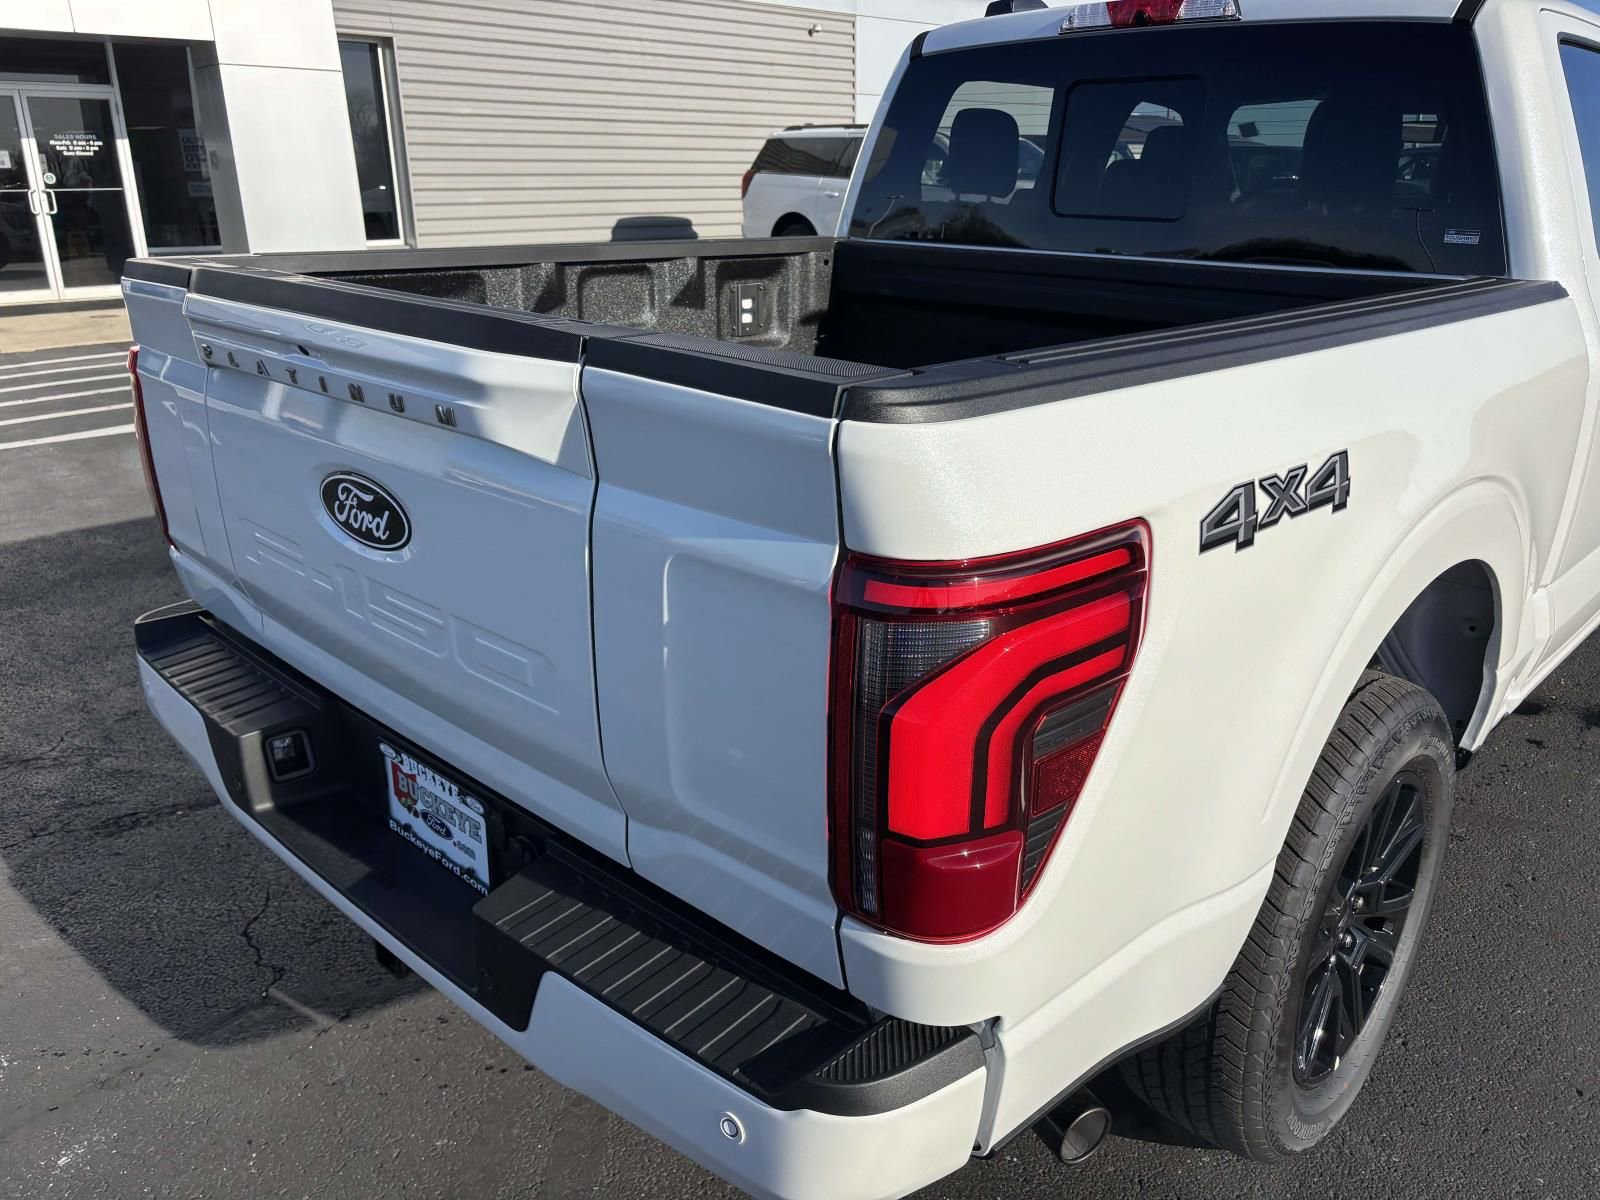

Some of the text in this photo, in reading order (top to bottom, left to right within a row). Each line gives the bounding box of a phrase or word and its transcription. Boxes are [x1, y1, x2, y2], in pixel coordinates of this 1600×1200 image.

[201, 343, 458, 427] PLATINUM
[239, 517, 560, 715] F-150
[398, 770, 482, 843] BUCKEYE
[389, 819, 489, 897] BuckeyeFord.com
